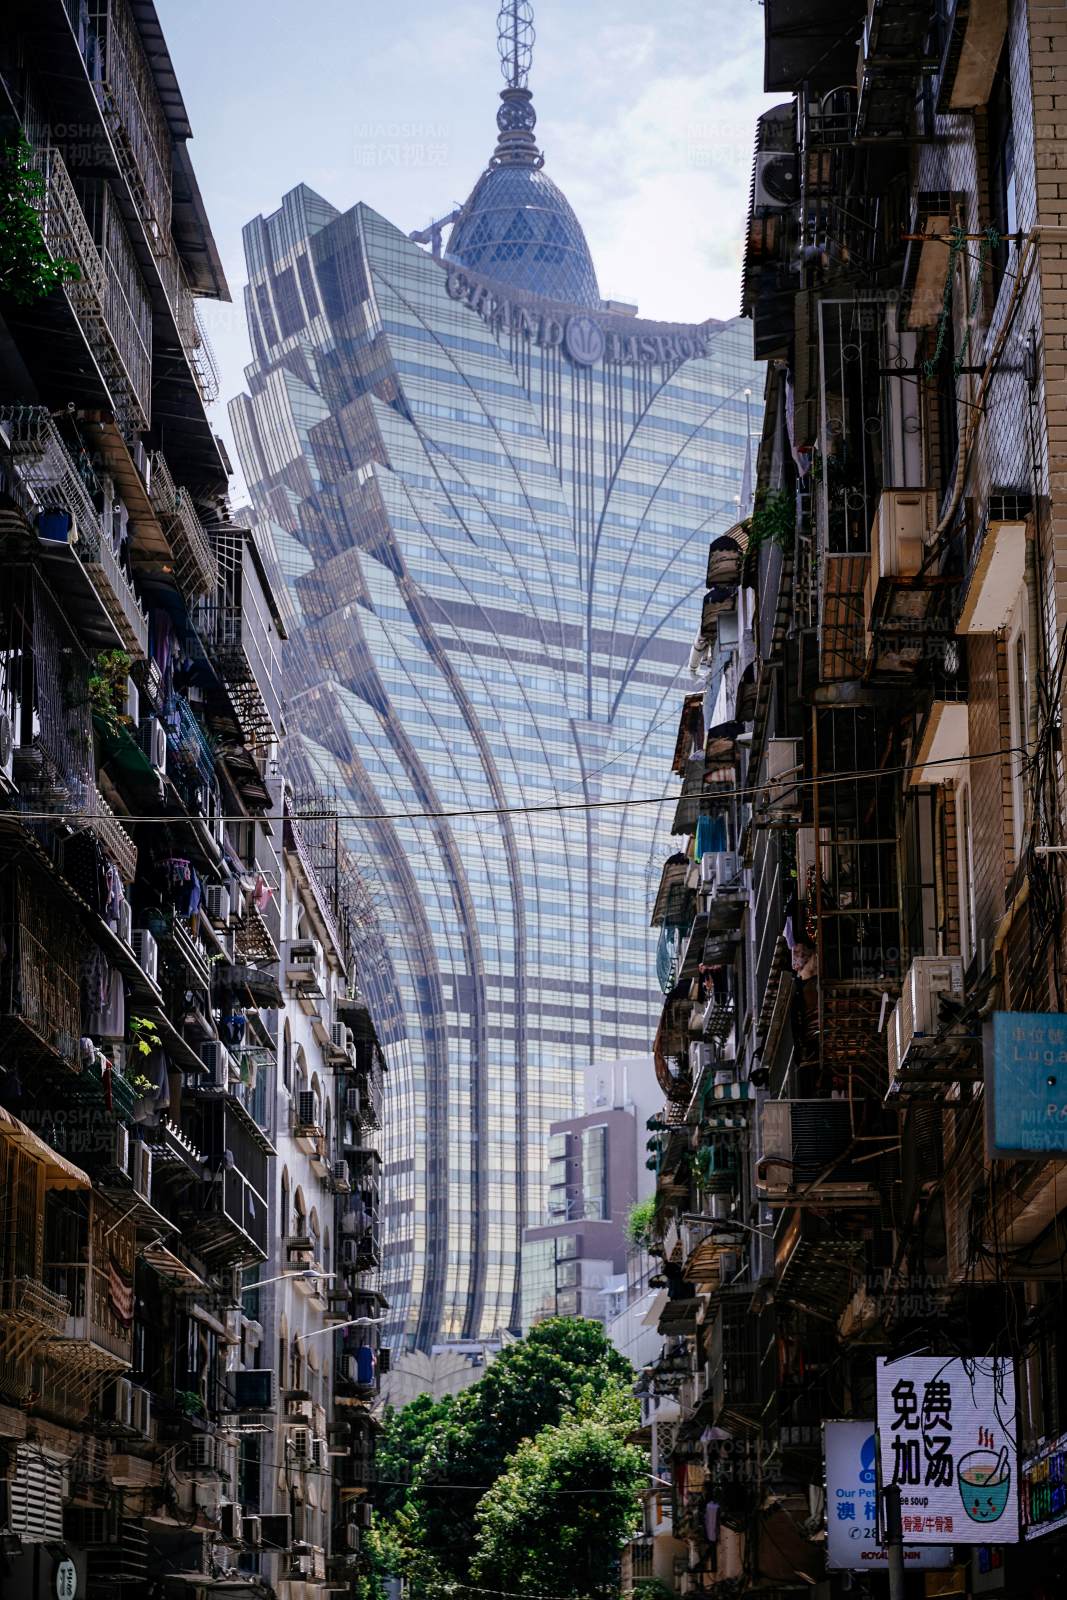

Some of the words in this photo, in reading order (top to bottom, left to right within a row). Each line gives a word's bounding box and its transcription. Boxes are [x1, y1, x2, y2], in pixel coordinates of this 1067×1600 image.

[447, 271, 565, 347] GRAND
[891, 1378, 952, 1431] 免费
[891, 1435, 953, 1487] 加汤
[836, 1488, 856, 1498] Our
[910, 1496, 928, 1508] soup
[901, 1516, 953, 1533] 骨湯/牛骨湯
[861, 1551, 889, 1560] ROYAL
